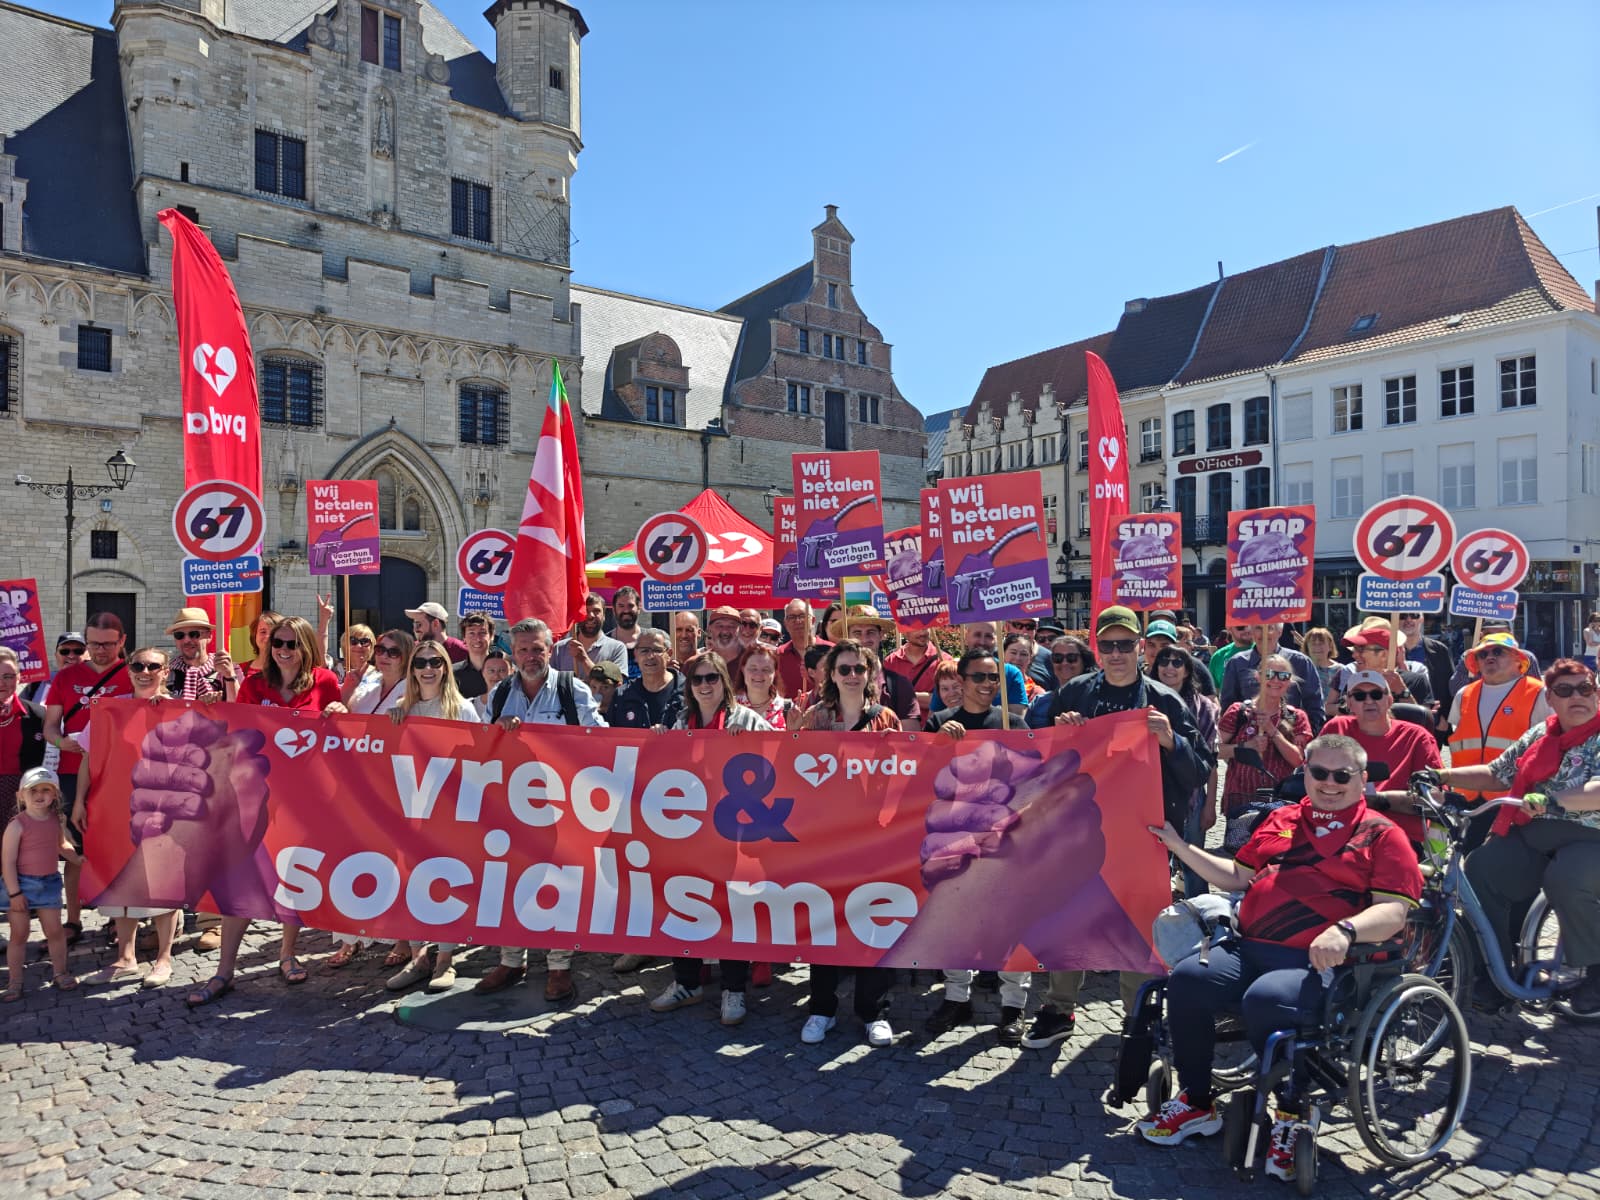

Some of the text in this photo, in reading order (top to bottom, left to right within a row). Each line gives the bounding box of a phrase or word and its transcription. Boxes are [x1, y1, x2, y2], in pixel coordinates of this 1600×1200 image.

[801, 459, 831, 479] Wij
[313, 485, 339, 500] Wij
[802, 477, 874, 493] betalen
[803, 494, 840, 510] niet
[948, 484, 984, 507] Wij
[314, 499, 374, 511] betalen
[315, 511, 346, 523] niet
[950, 503, 1035, 524] betalen
[190, 506, 245, 540] 67
[1238, 518, 1305, 541] STOP
[952, 524, 996, 544] niet
[1118, 522, 1173, 541] STOP
[1373, 524, 1435, 558] 67
[649, 535, 693, 564] 67
[826, 543, 870, 557] voor hun
[469, 549, 513, 576] 67
[830, 552, 876, 564] oorlogen
[1114, 560, 1134, 571] WAR
[1134, 555, 1178, 568] CRIMINALS
[1465, 549, 1514, 576] 67
[189, 560, 249, 572] Handen af
[1231, 557, 1309, 577] WAR CRIMINALS
[190, 571, 233, 581] van ons
[190, 580, 243, 592] pensioen
[647, 582, 696, 592] Handen af
[704, 582, 734, 594] vda
[982, 582, 1032, 597] voor hun
[1127, 580, 1168, 589] TRUMP
[1366, 580, 1431, 589] Handen af
[0, 590, 28, 609] OP
[464, 592, 499, 601] Handen
[986, 590, 1039, 605] oorlogen
[1116, 588, 1177, 598] NETANYAHU
[1244, 587, 1296, 598] TRUMP
[1391, 591, 1413, 599] ons
[1458, 590, 1508, 602] Handen af
[648, 600, 690, 608] pensioen
[1232, 598, 1306, 609] NETANYAHU
[1365, 598, 1421, 608] pensioen
[1456, 605, 1499, 615] pensioen
[322, 733, 385, 754] pvda
[846, 754, 917, 780] pvda
[390, 745, 801, 843] vrede &
[1312, 811, 1335, 819] pvd
[273, 829, 919, 949] socialisme
